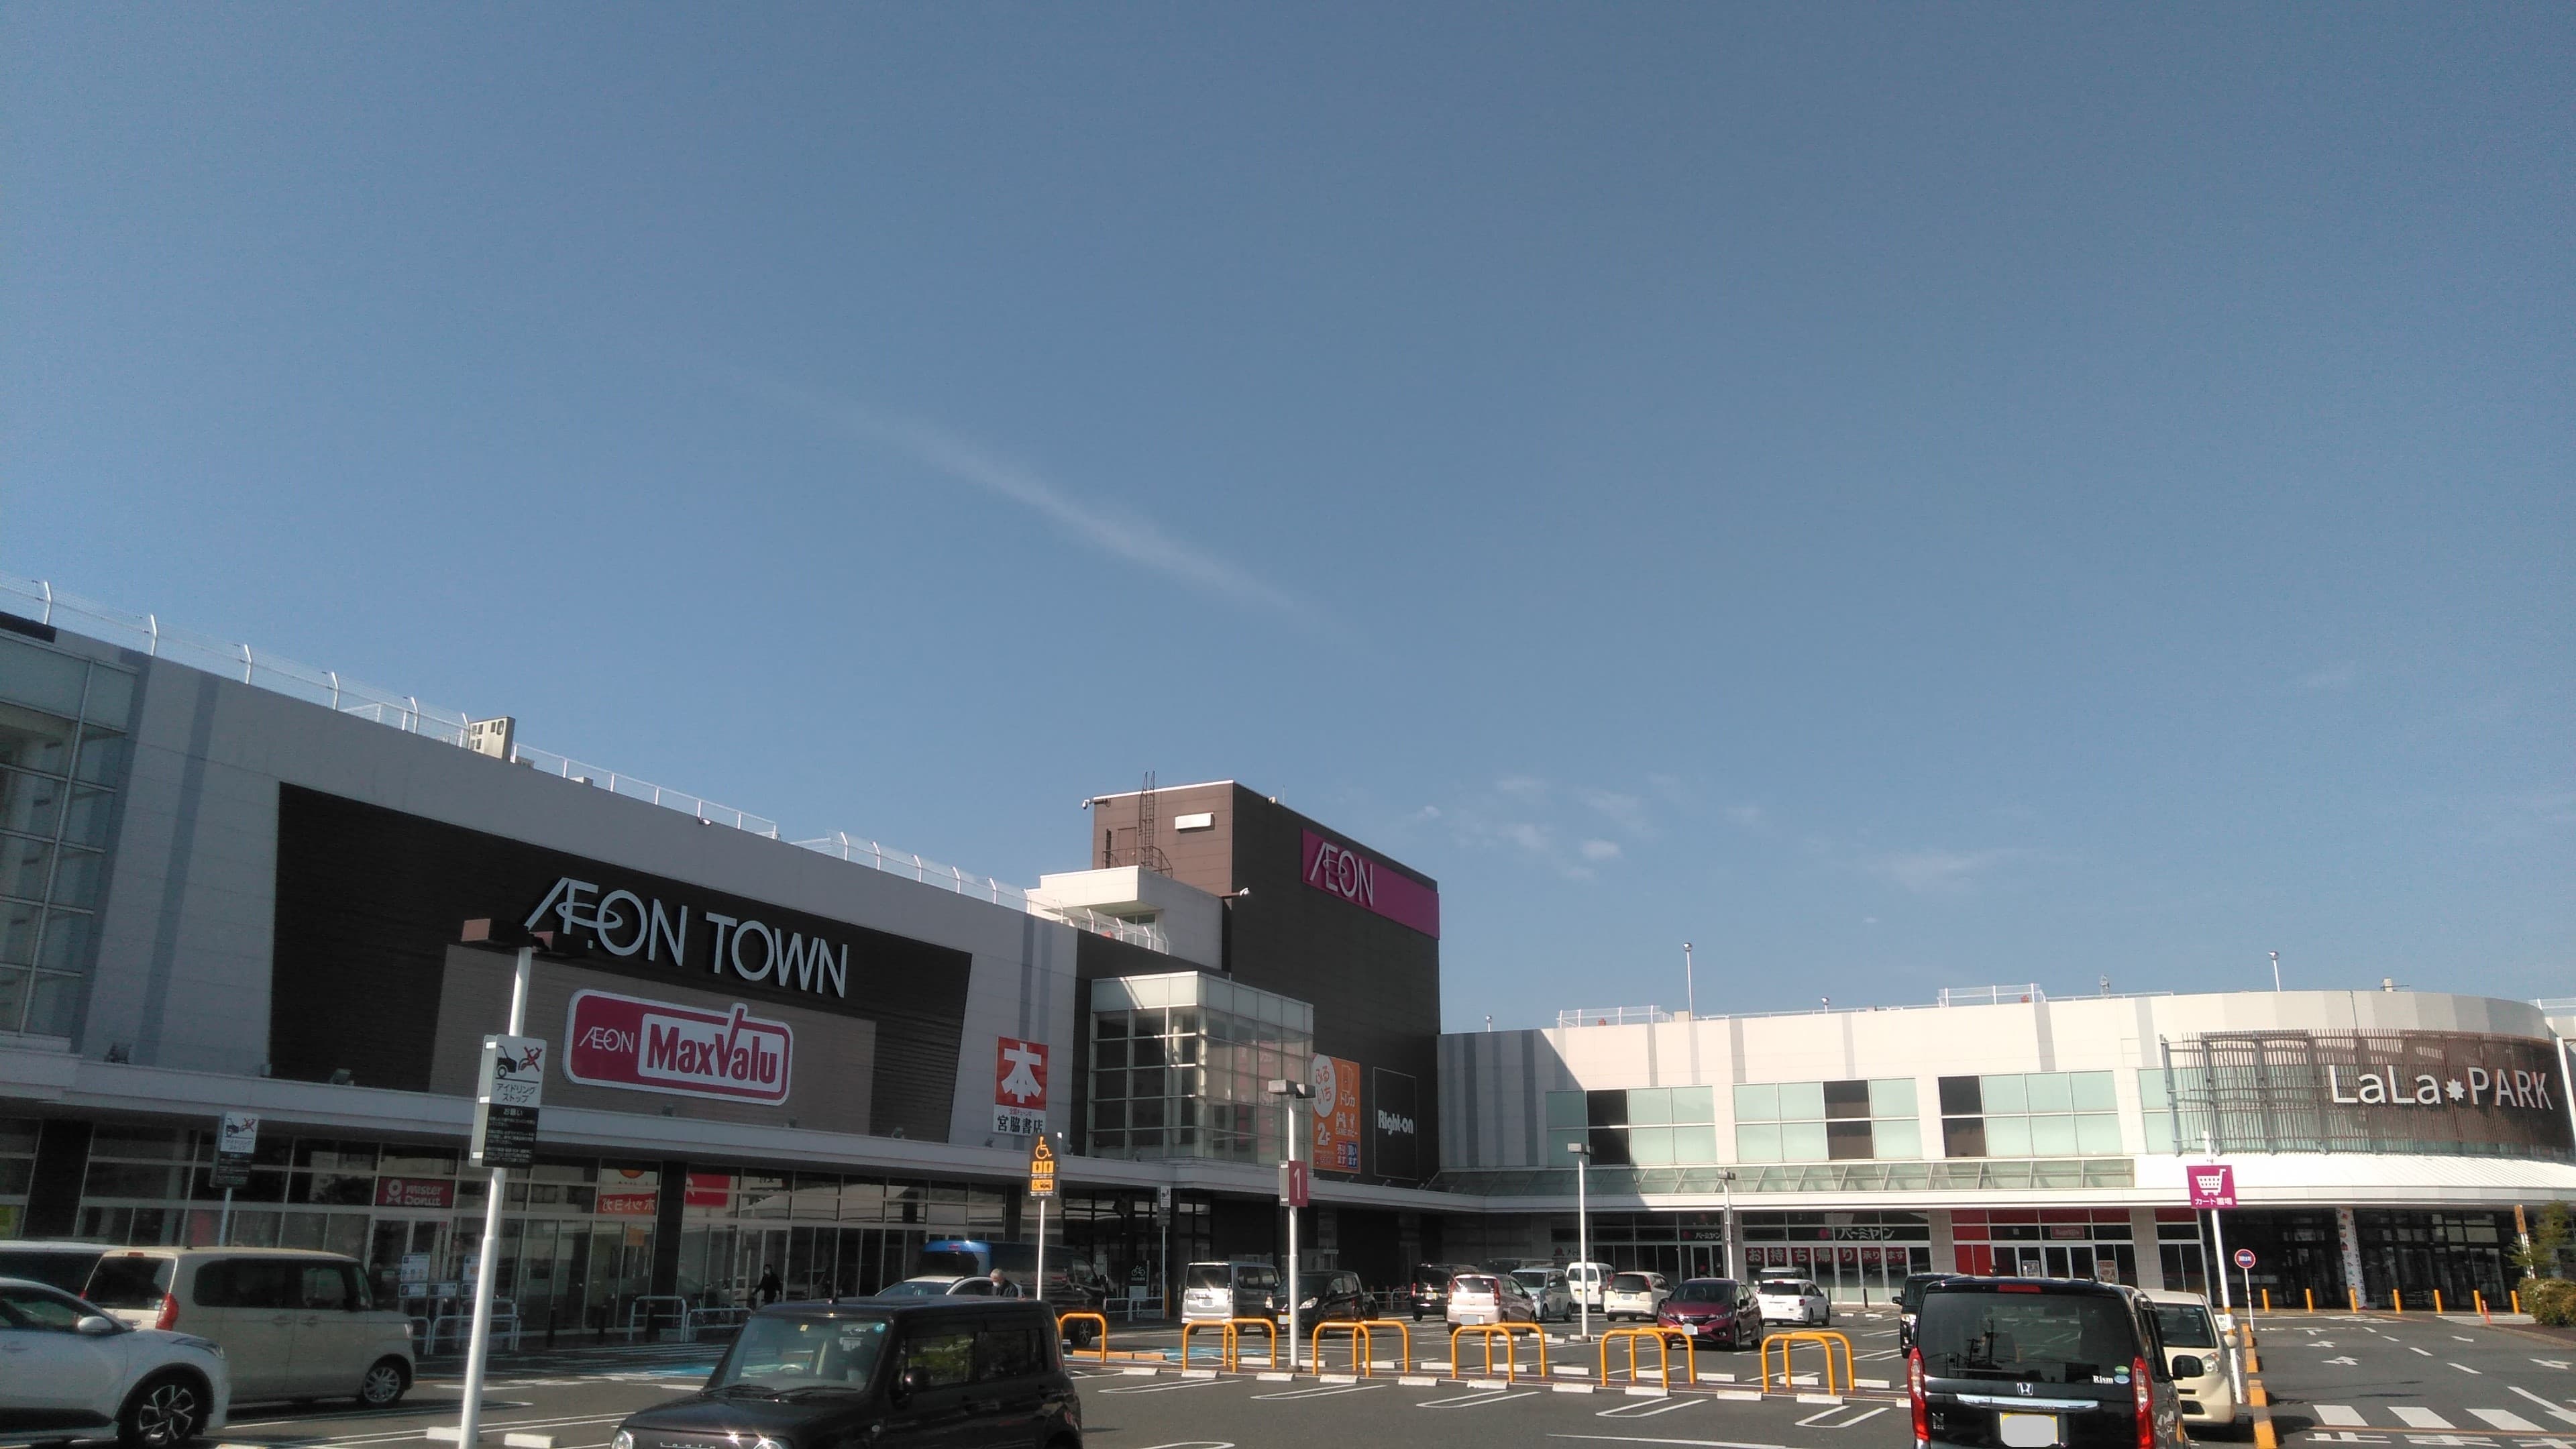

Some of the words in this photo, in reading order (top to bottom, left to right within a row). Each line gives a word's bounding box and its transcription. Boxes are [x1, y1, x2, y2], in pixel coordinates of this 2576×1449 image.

[706, 912, 849, 998] TOWN
[646, 1008, 778, 1084] MaxValu
[1001, 1042, 1042, 1104] 本
[1316, 1065, 1330, 1085] ふる
[496, 1083, 536, 1095] アイドリング
[502, 1093, 529, 1104] ストップ
[1317, 1087, 1332, 1105] いち
[2328, 1065, 2442, 1104] LaLa
[2467, 1067, 2553, 1110] PARK
[997, 1114, 1042, 1134] 宮脇書店
[1318, 1122, 1331, 1146] 2F
[1293, 1168, 1300, 1199] 1
[1838, 1227, 1894, 1240] バーミヤン
